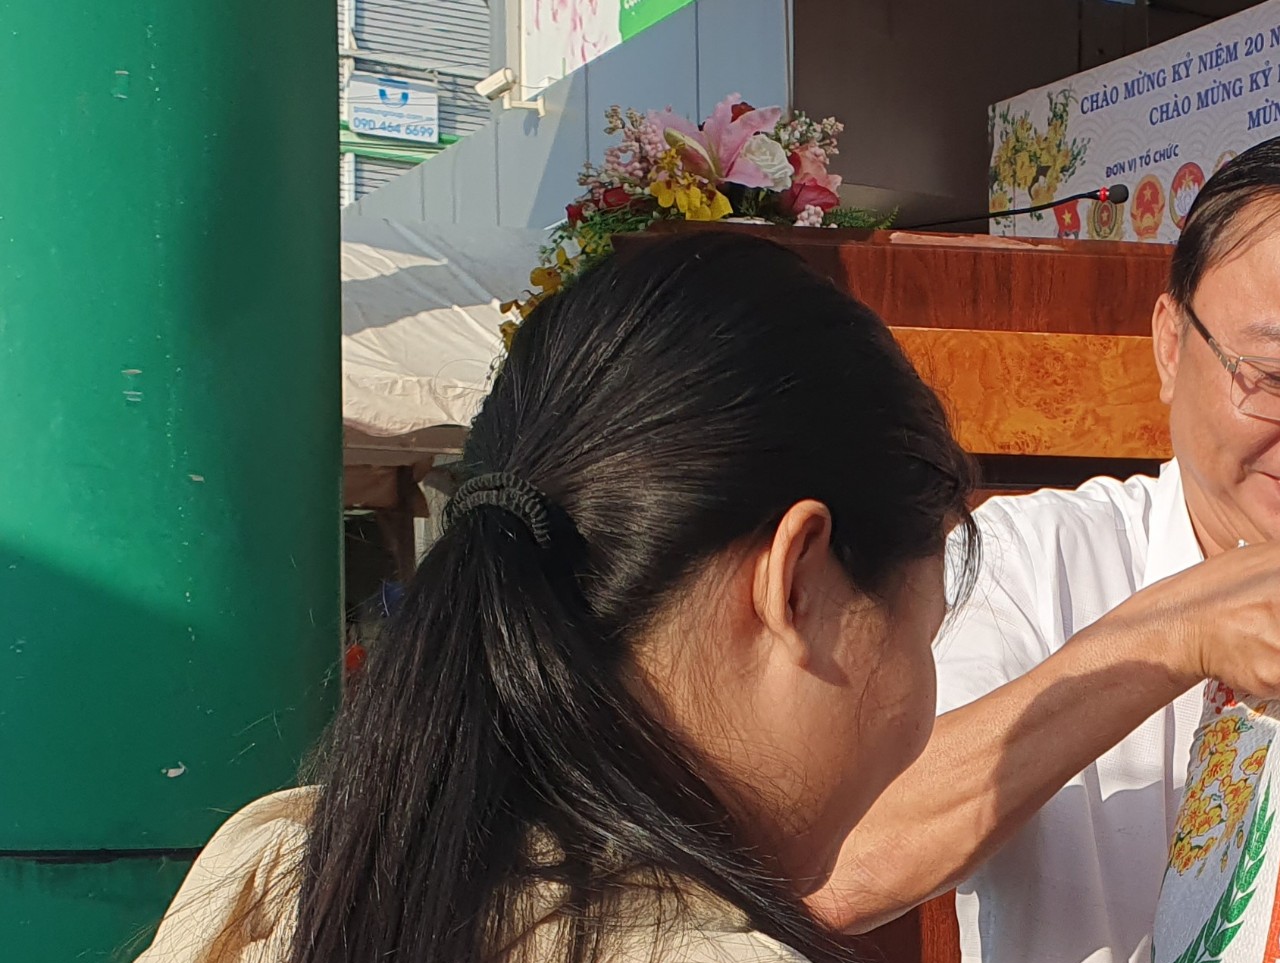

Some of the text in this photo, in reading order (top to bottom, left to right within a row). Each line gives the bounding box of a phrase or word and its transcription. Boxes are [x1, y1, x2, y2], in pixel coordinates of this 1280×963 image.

[1080, 85, 1119, 115] CHÀO
[1123, 69, 1167, 100] MỪNG
[1171, 52, 1193, 83] KỶ
[1198, 42, 1238, 72] NIỆM
[1245, 33, 1265, 57] 20
[1149, 94, 1190, 126] CHÀO
[1196, 79, 1244, 110] MỪNG
[1249, 60, 1273, 92] KỶ
[1105, 160, 1127, 178] ĐƠN
[1127, 159, 1137, 174] VỊ
[1153, 144, 1180, 164] CHỨC
